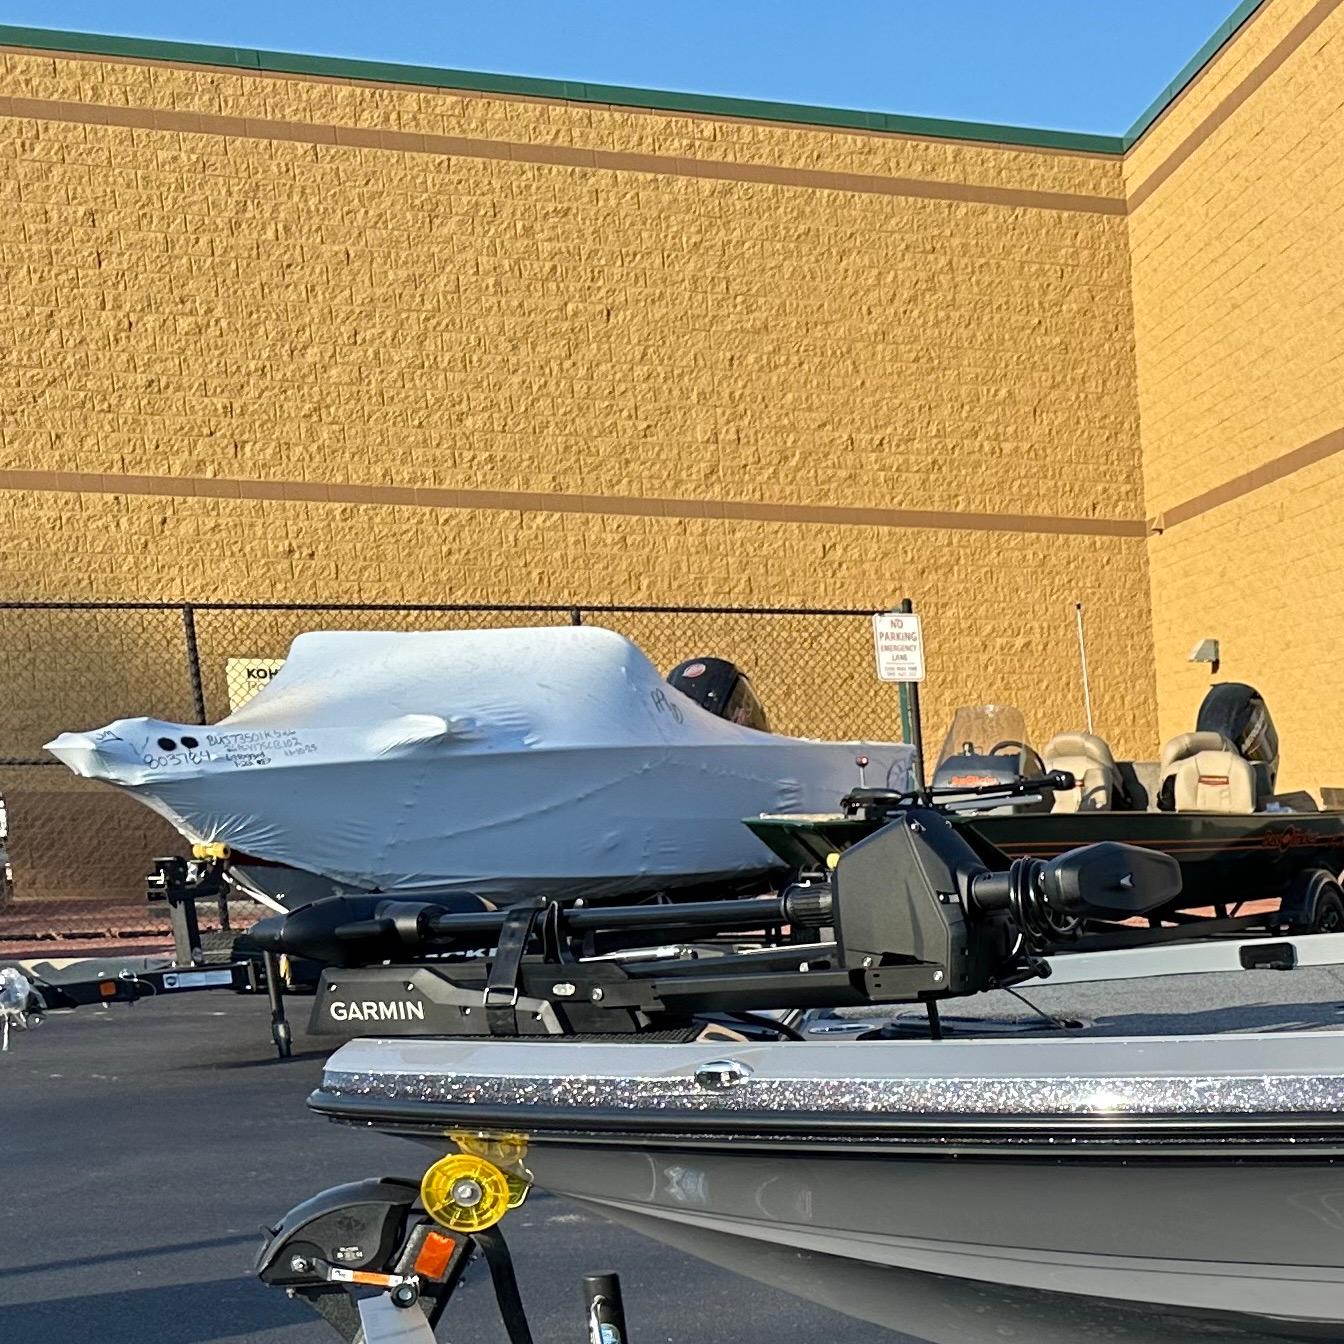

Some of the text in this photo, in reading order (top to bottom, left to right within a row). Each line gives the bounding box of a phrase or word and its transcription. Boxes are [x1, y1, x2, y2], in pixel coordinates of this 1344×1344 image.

[890, 618, 904, 629] NO
[879, 631, 918, 642] PARKING
[330, 1000, 425, 1021] GARMIN
